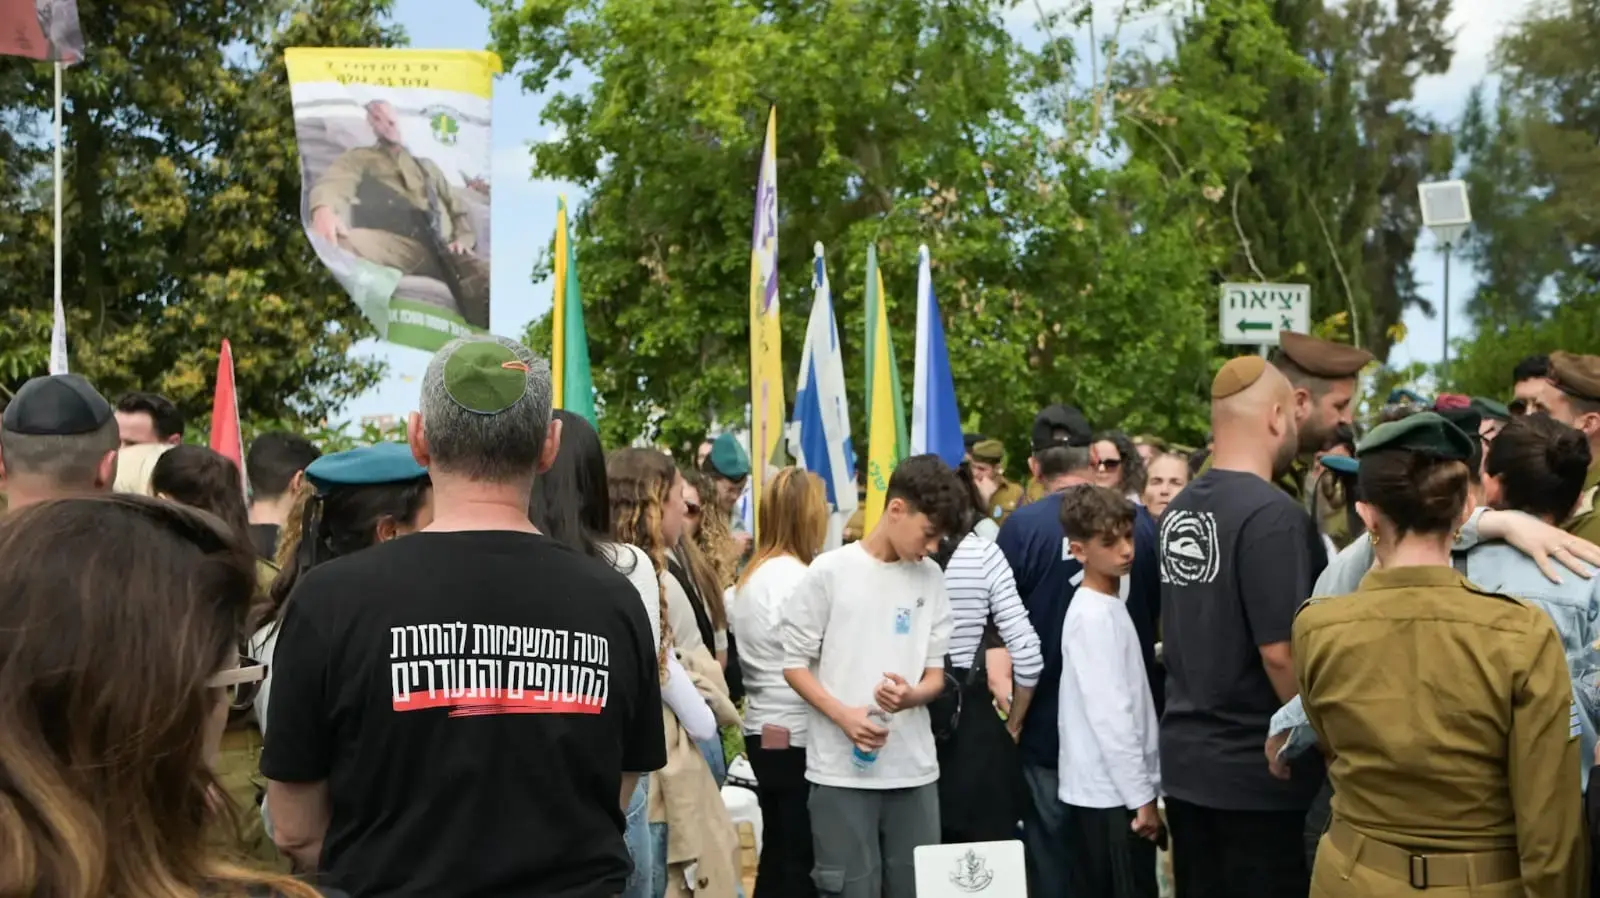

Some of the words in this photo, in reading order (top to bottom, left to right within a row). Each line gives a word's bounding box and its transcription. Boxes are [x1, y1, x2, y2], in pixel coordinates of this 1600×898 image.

[1230, 290, 1302, 310] יציאה
[390, 621, 467, 659] להחזרת
[471, 623, 569, 661] המשפחות
[573, 631, 609, 667] מטה
[391, 658, 502, 703] והנעדרים
[507, 661, 609, 708] החטופים
